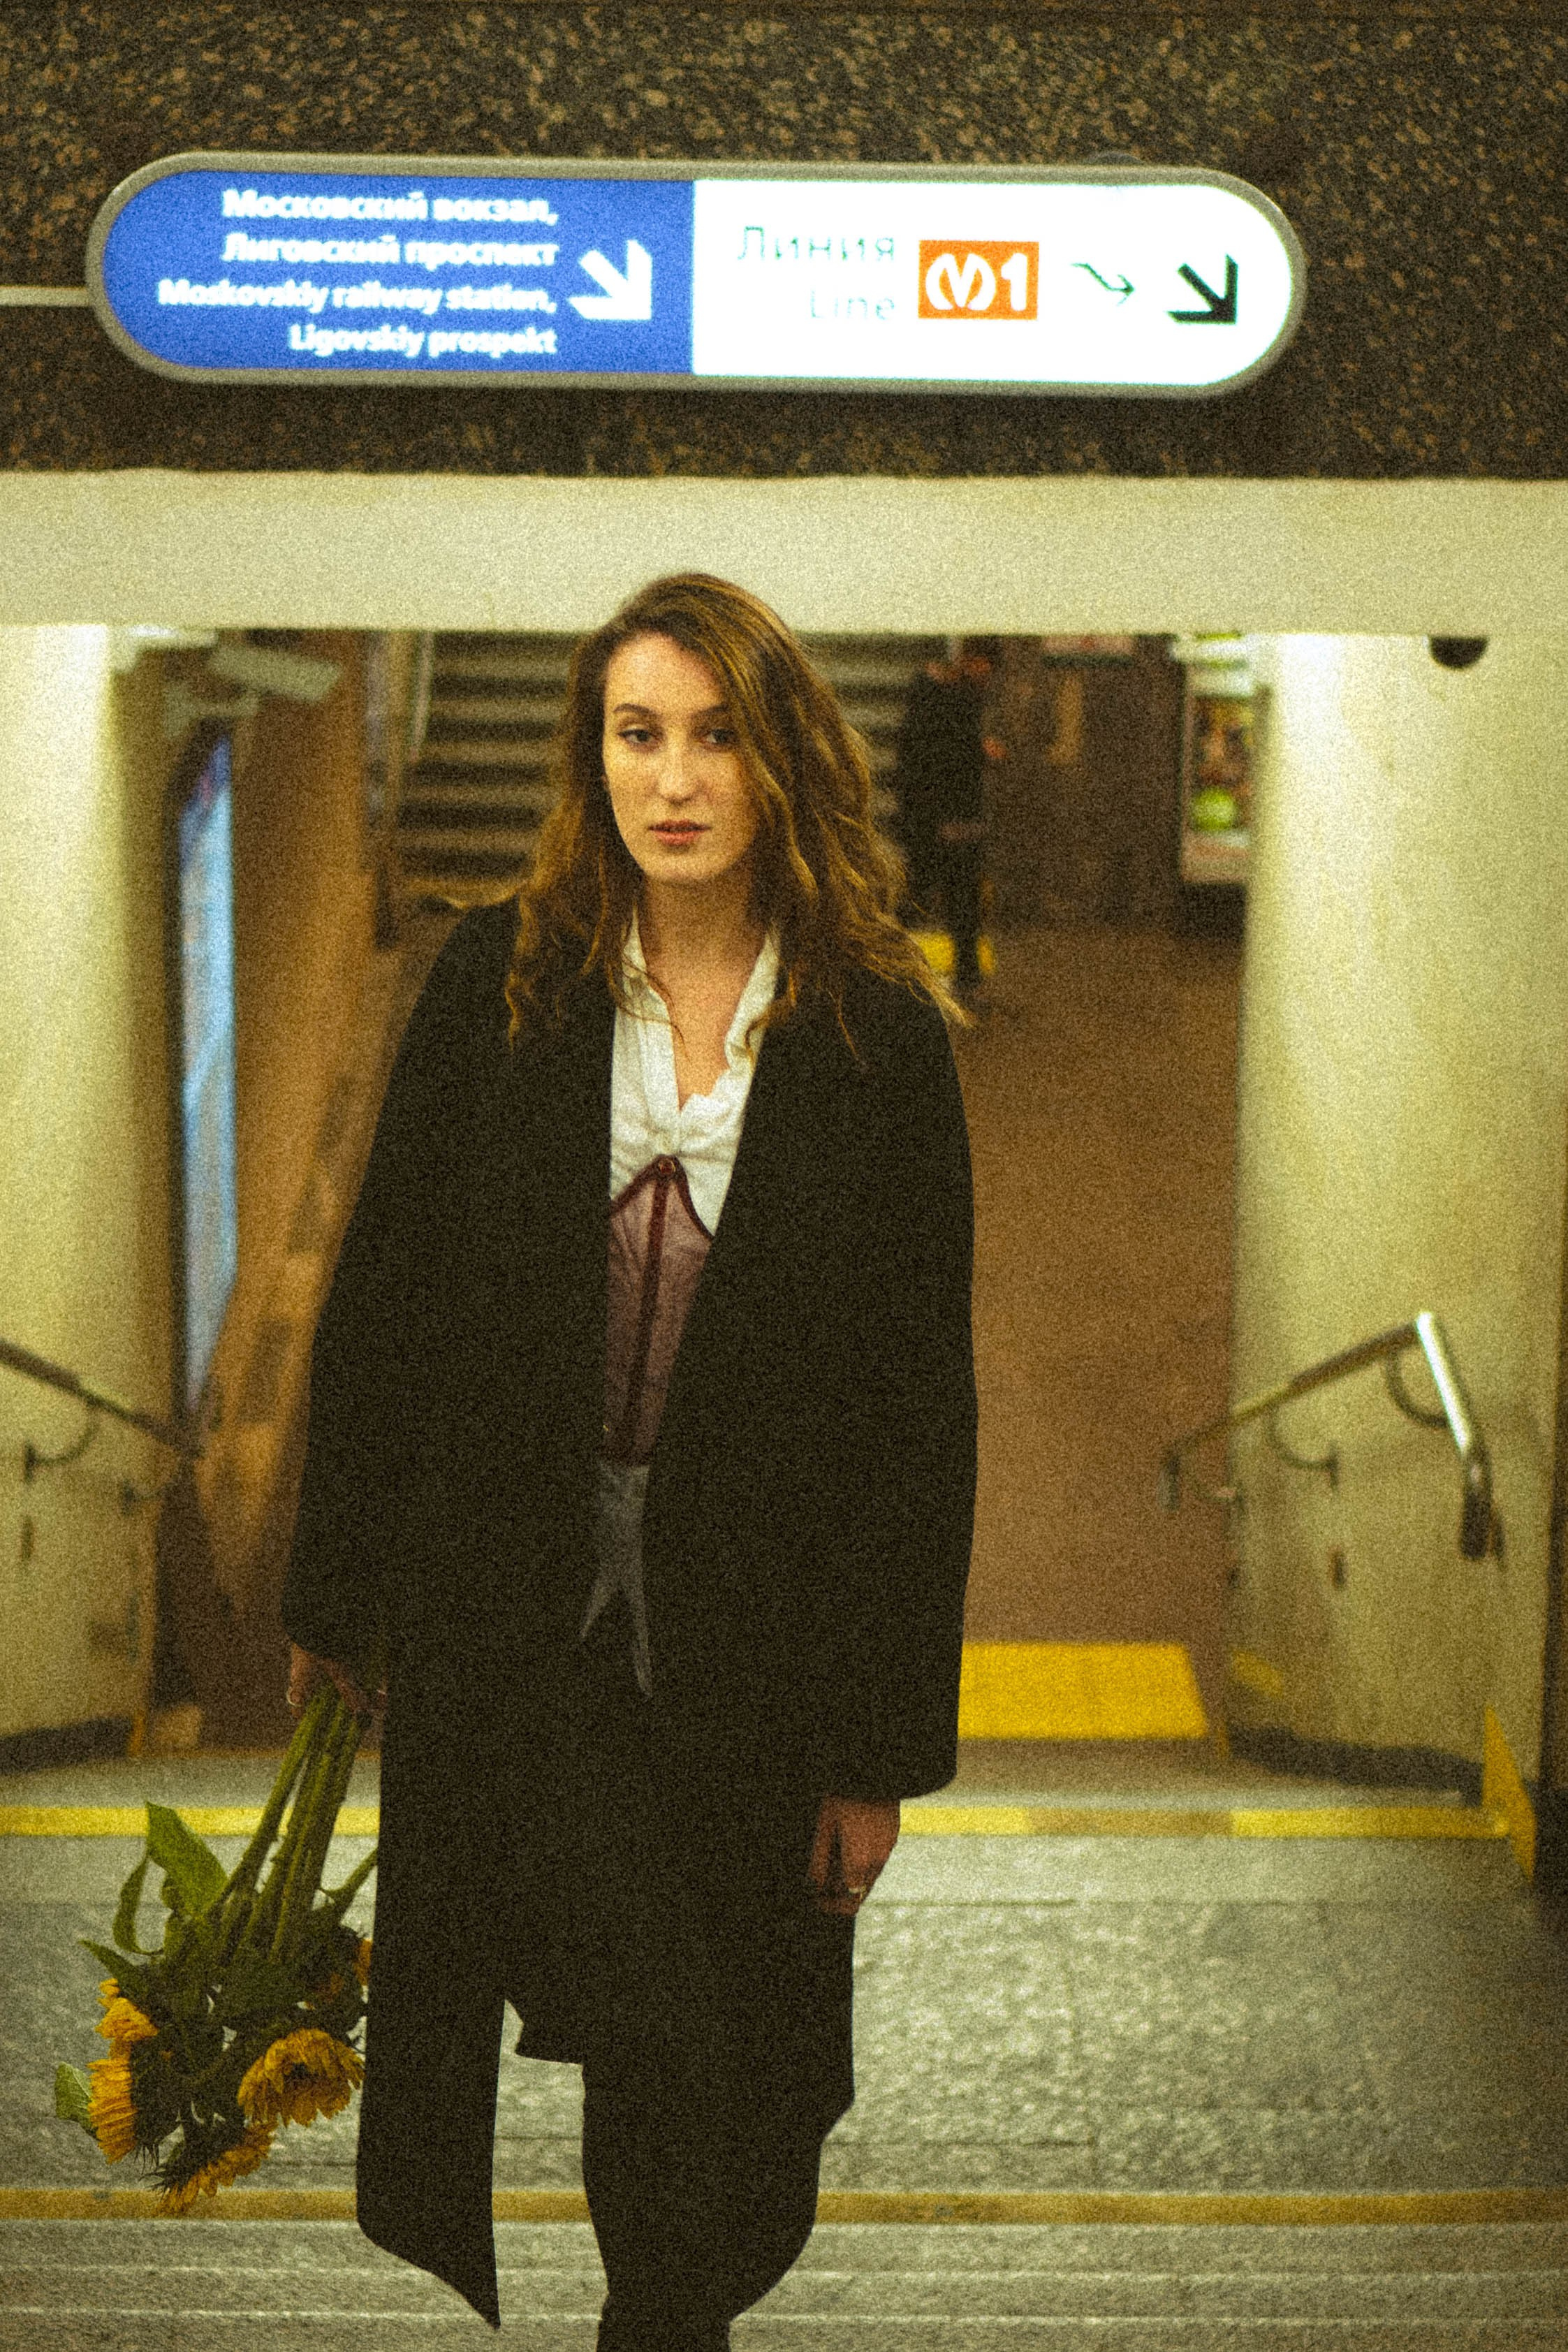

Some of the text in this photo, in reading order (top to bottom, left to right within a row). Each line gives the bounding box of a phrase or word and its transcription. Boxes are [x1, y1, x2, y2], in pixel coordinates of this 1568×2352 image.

[224, 190, 557, 225] Московский вокзал,
[222, 233, 558, 270] Лиговский проспект
[737, 225, 895, 261] Линия
[159, 279, 328, 313] Moskovskiy
[332, 281, 443, 314] railway
[810, 291, 896, 321] Line
[291, 324, 557, 358] Ligovskiy prospekt
